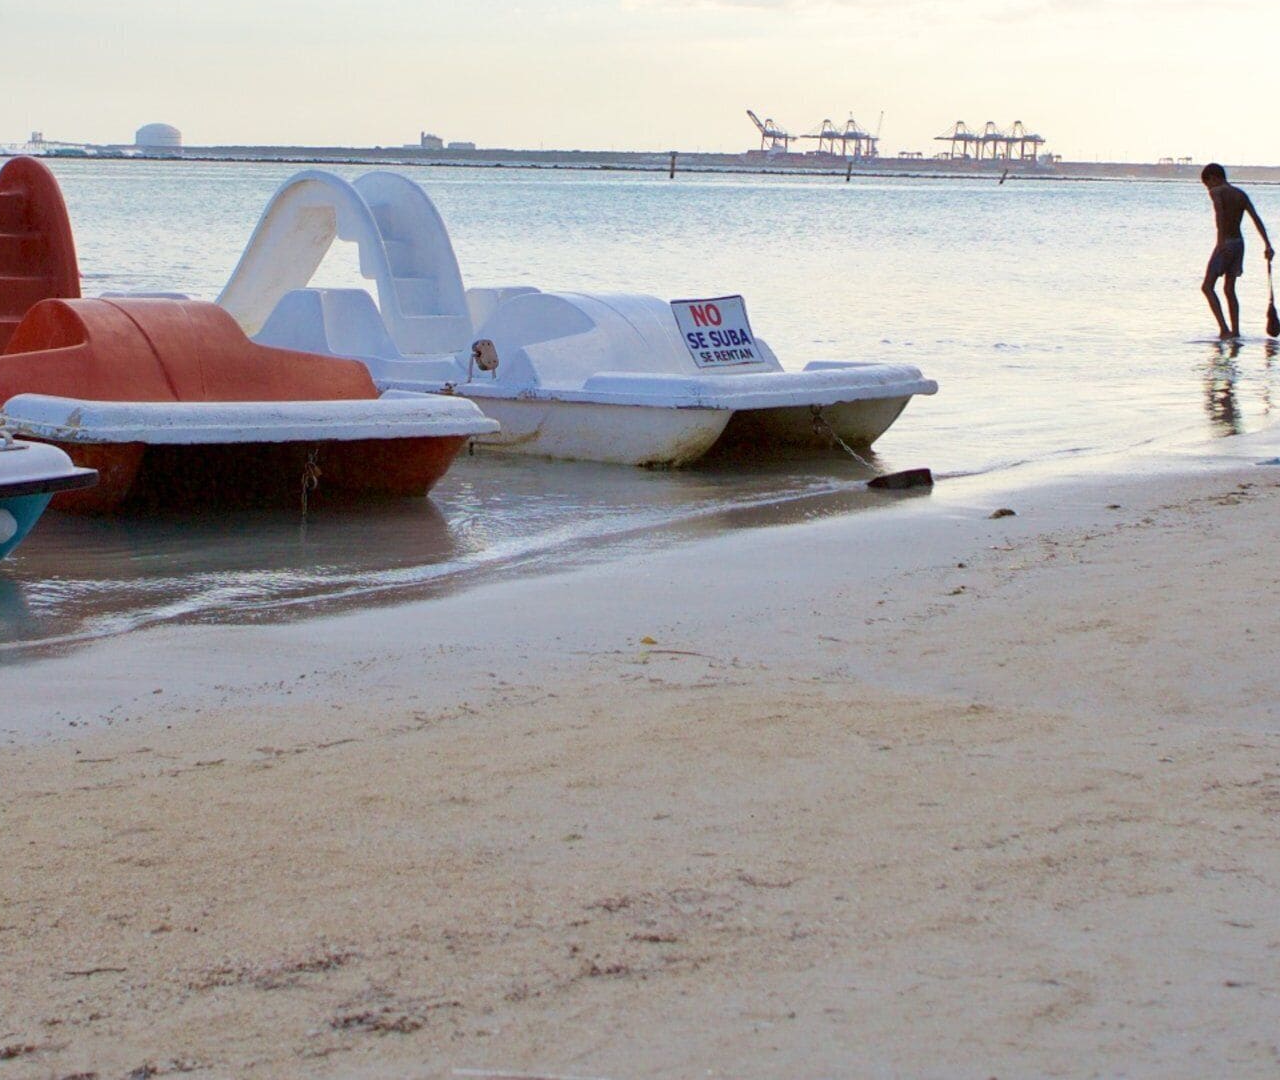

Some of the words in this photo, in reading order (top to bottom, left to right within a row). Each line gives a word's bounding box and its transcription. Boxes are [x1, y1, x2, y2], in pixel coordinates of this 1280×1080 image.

[689, 304, 722, 327] NO
[687, 332, 709, 349] SE
[709, 329, 751, 347] SUBA
[700, 351, 714, 362] SE
[714, 348, 754, 361] RENTAN
